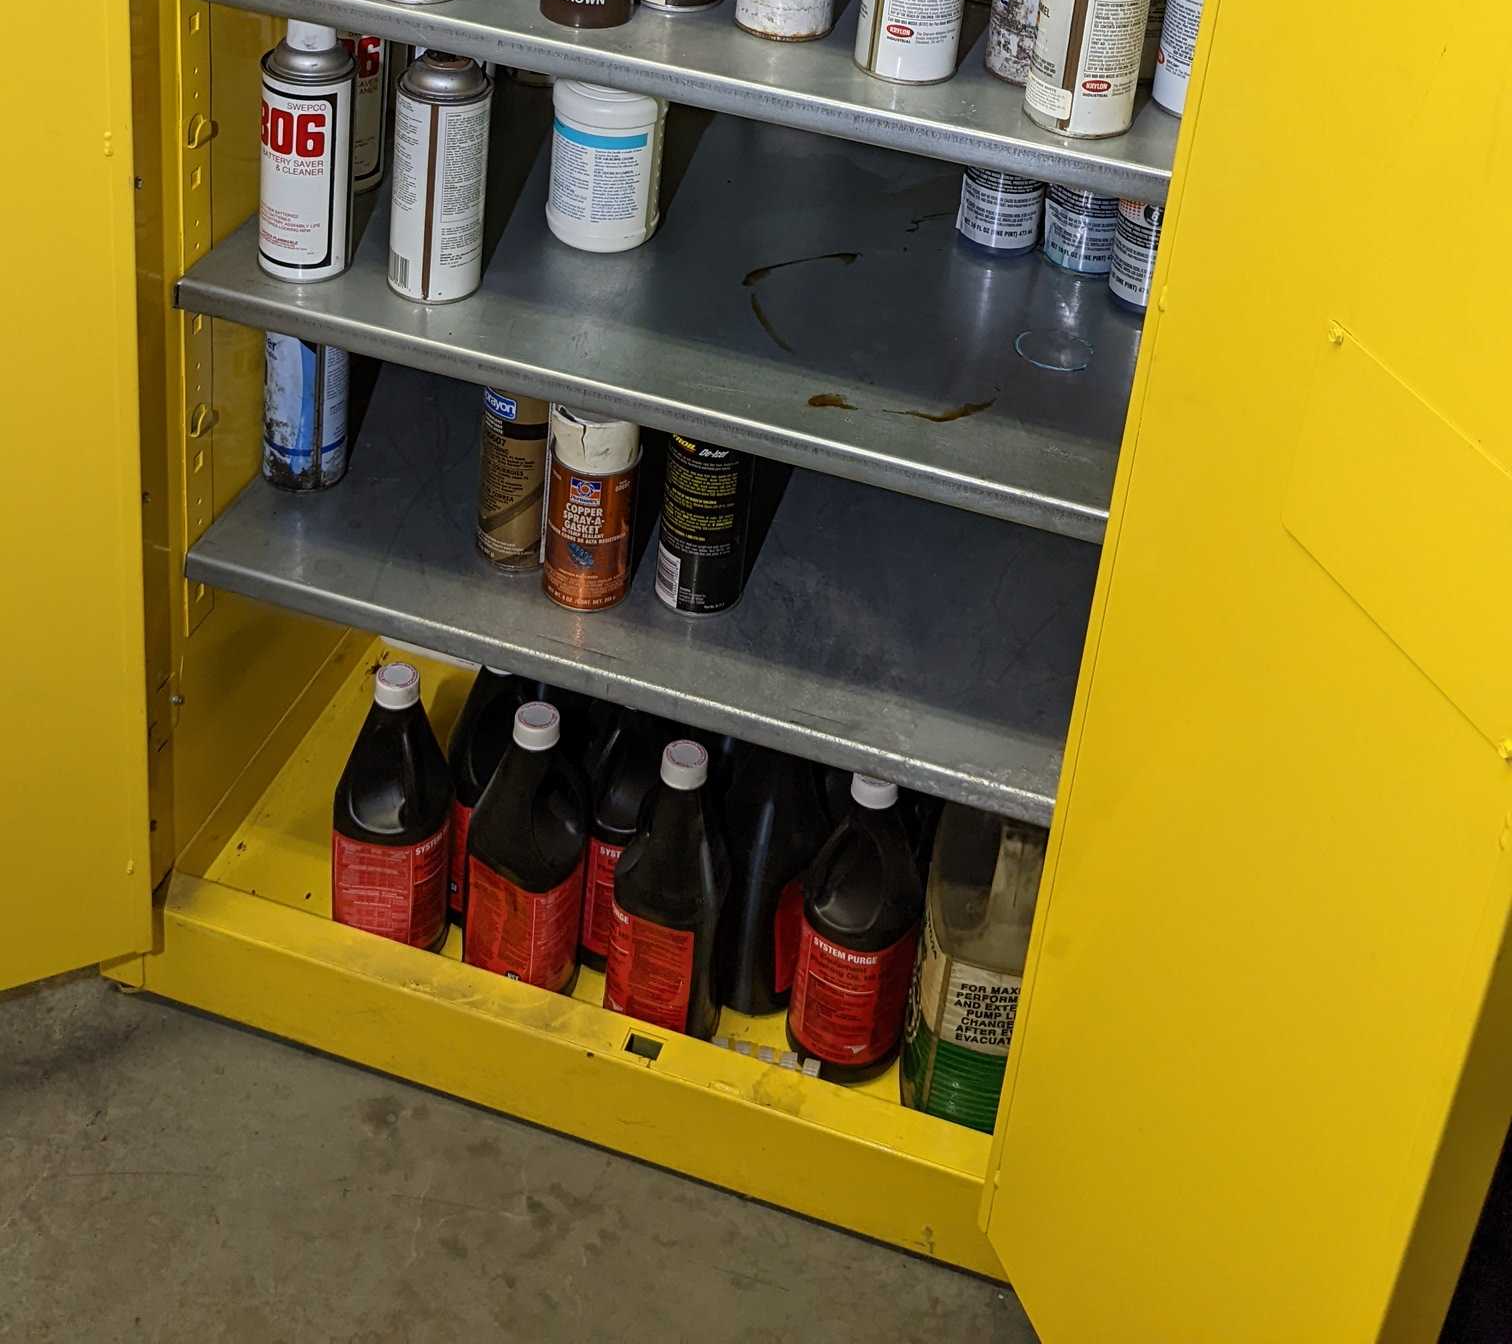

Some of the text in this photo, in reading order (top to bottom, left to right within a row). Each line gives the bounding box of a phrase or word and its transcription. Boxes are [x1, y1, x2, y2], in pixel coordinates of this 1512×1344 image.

[287, 102, 327, 112] SWEPCO
[294, 160, 324, 168] SAVER
[282, 167, 324, 176] CLEANER
[1004, 230, 1018, 238] PINT)
[1124, 280, 1137, 292] PINT)
[699, 449, 729, 458] De-Icer
[566, 503, 603, 516] COPPER
[563, 510, 605, 525] SPRAY-A-
[564, 520, 600, 534] GASKET
[813, 936, 878, 965] SYSTEM PURGE
[961, 983, 987, 993] FOR
[956, 991, 1018, 1003] PERFORM
[954, 999, 1017, 1012] AND EXTE
[967, 1009, 1002, 1019] PUMP
[961, 1017, 1015, 1029] CHANGE
[955, 1024, 997, 1036] AFTER
[955, 1032, 1012, 1046] EVACUAT
